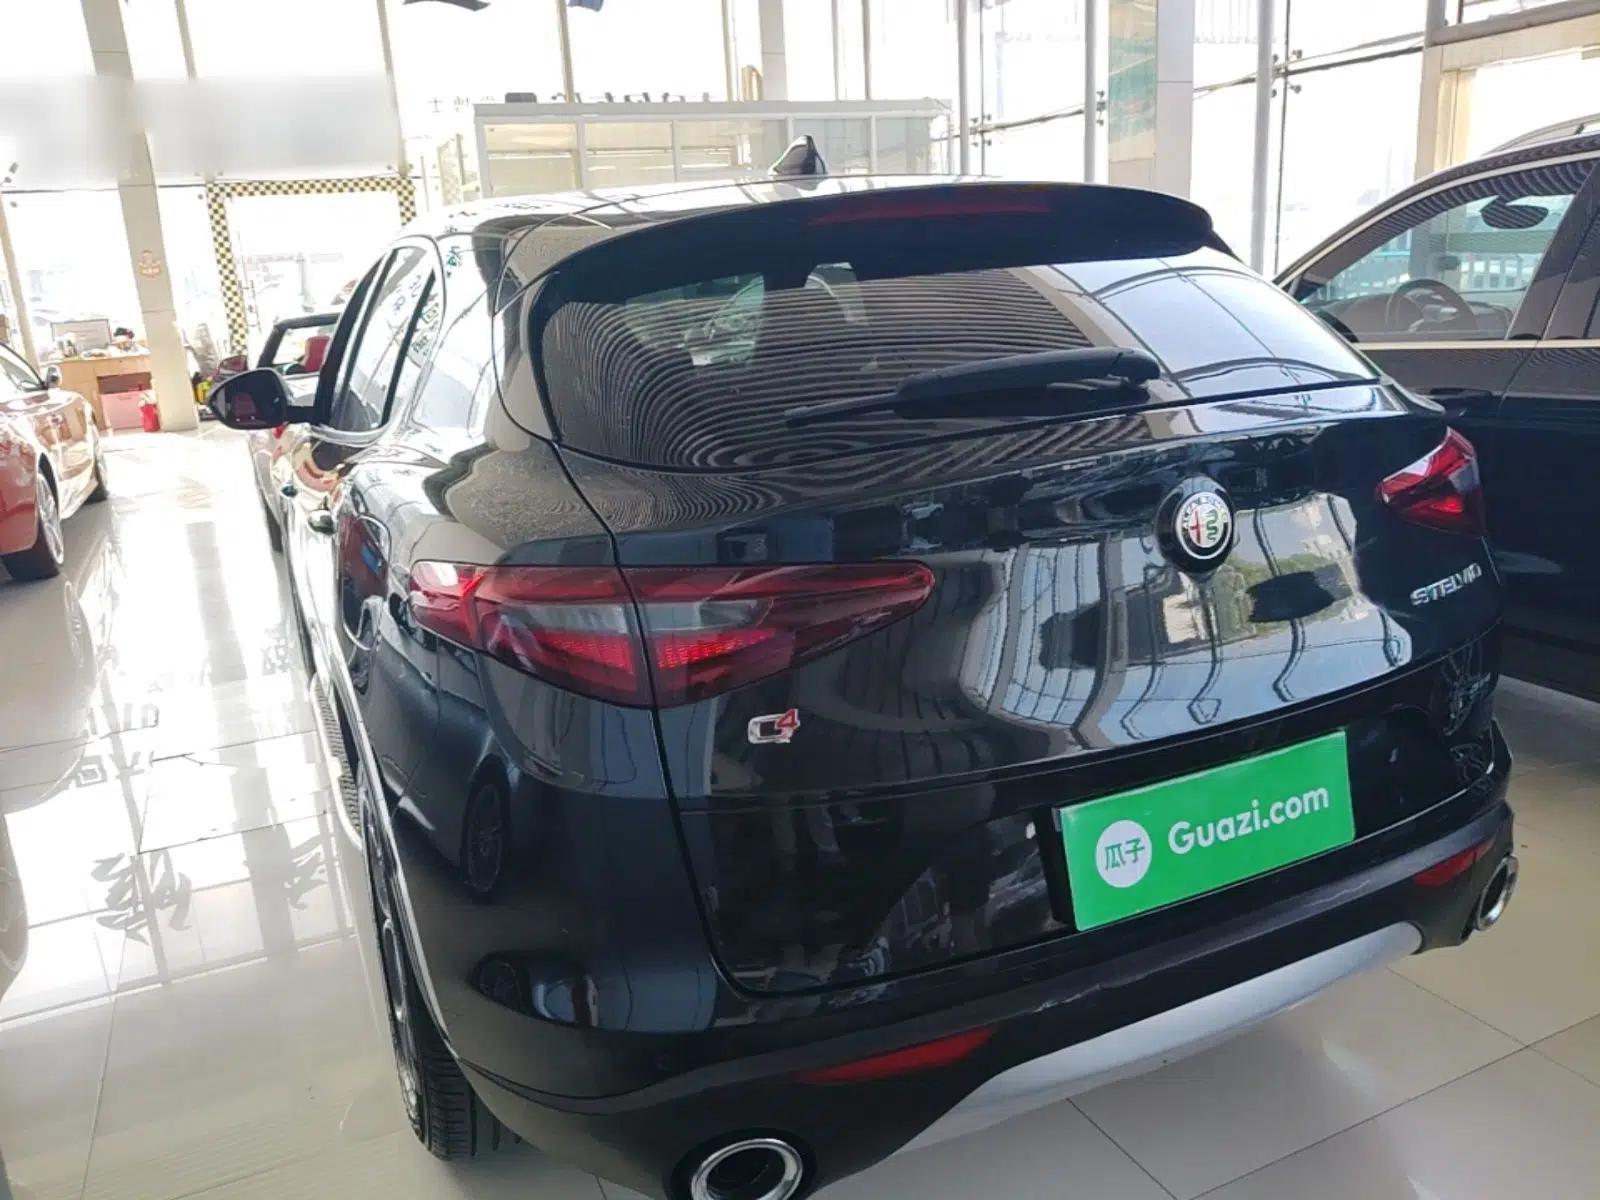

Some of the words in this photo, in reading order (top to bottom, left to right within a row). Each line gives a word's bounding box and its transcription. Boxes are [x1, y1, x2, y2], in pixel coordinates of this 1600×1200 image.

[1409, 562, 1483, 606] STELVIO
[747, 708, 801, 744] Q4
[1168, 787, 1329, 855] Guazi.com
[1104, 837, 1146, 871] 瓜子
